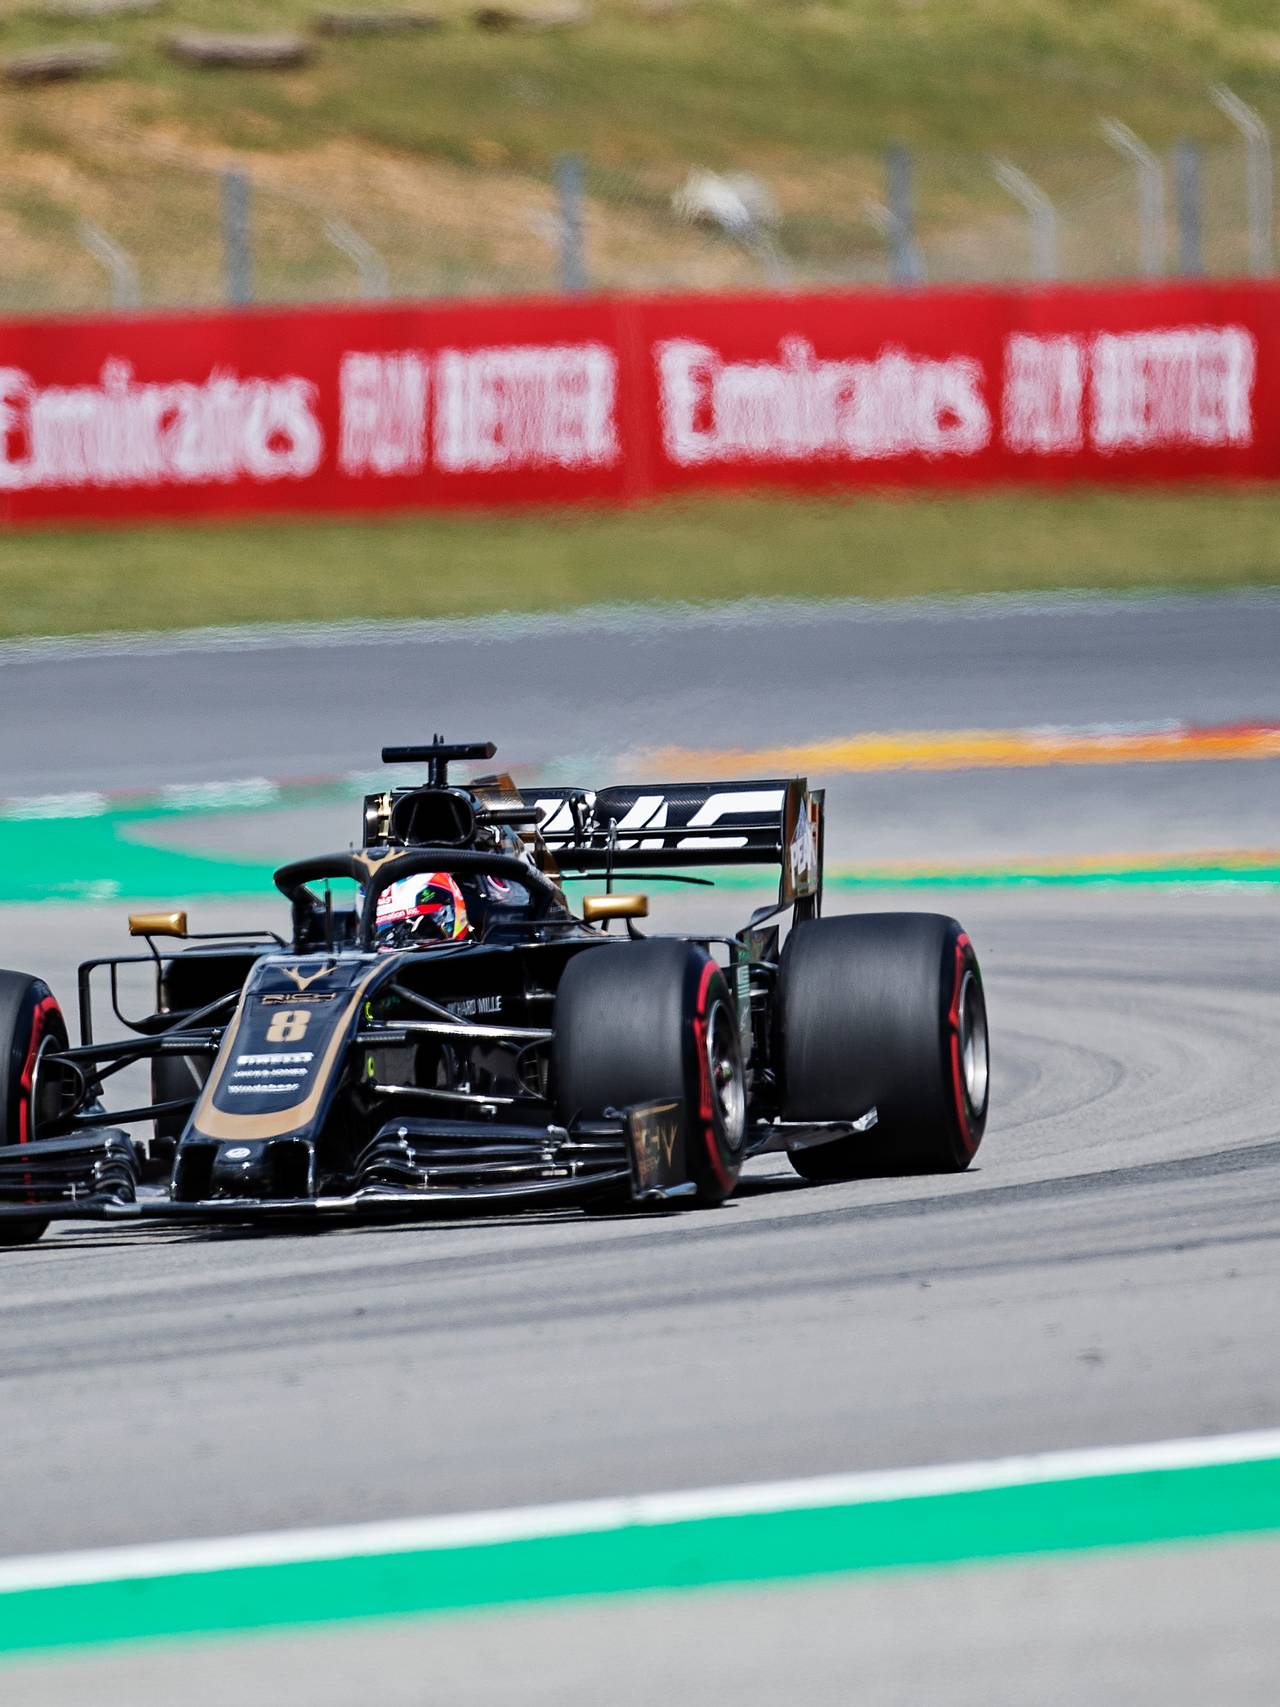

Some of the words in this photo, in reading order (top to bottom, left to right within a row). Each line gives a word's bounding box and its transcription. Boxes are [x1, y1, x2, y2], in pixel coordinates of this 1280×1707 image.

[654, 334, 991, 465] Emirates
[477, 995, 503, 1013] MILLE
[266, 1010, 312, 1042] 8
